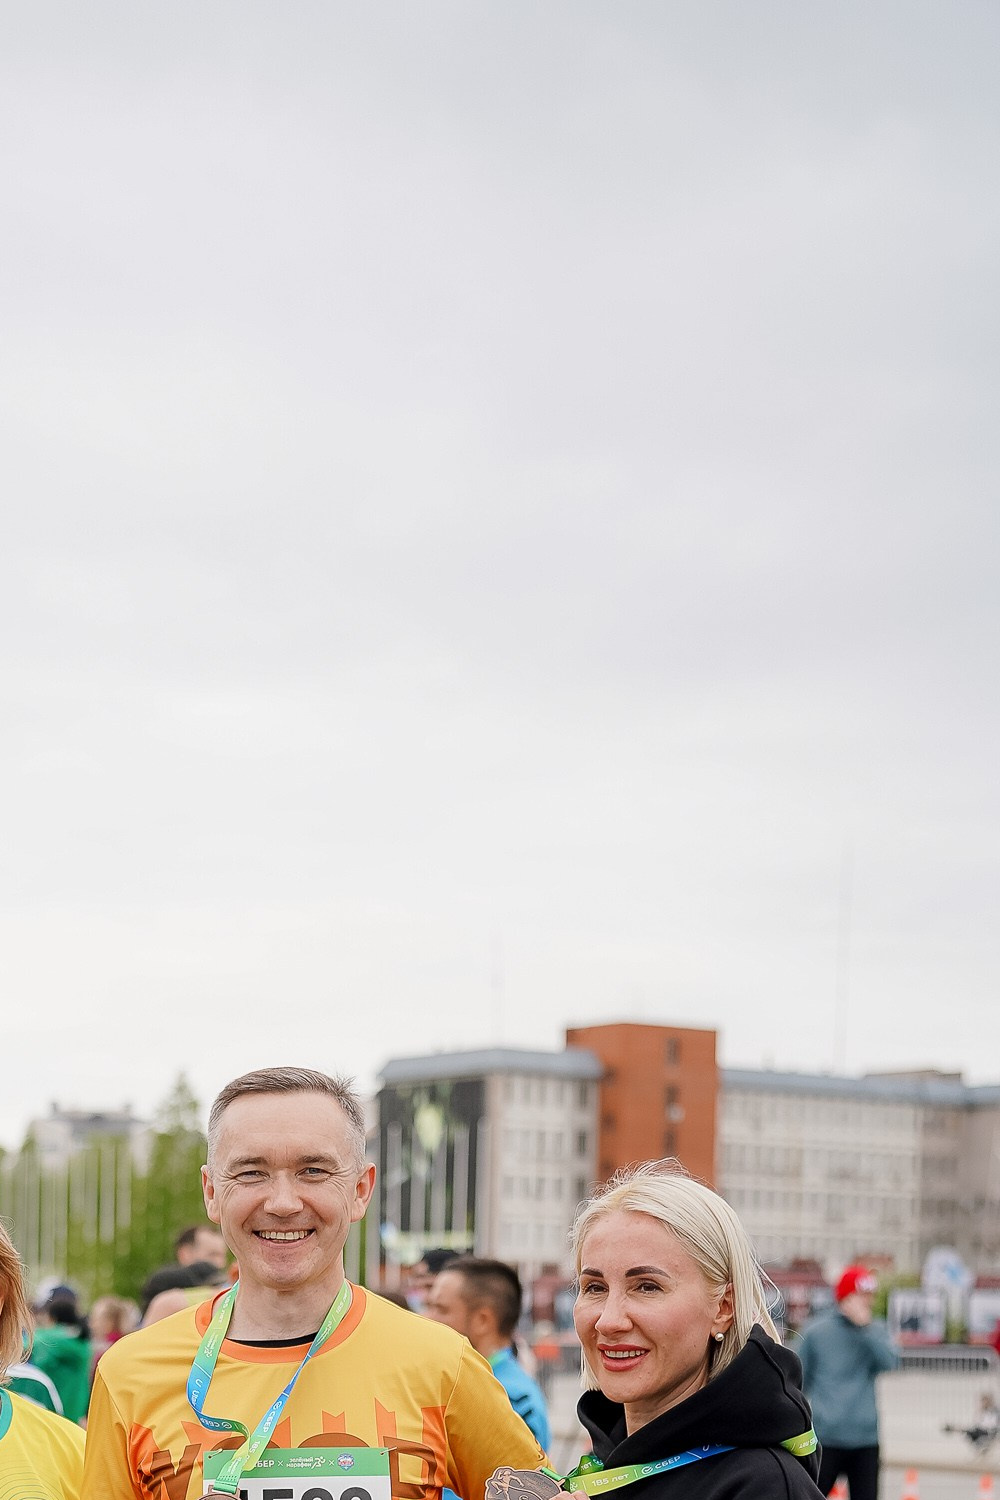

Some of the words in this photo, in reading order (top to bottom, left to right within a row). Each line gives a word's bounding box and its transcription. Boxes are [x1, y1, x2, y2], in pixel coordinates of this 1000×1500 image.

[254, 1460, 275, 1468] БЕР
[592, 1478, 609, 1487] 185
[611, 1473, 630, 1482] лет
[654, 1455, 681, 1469] СБЕР
